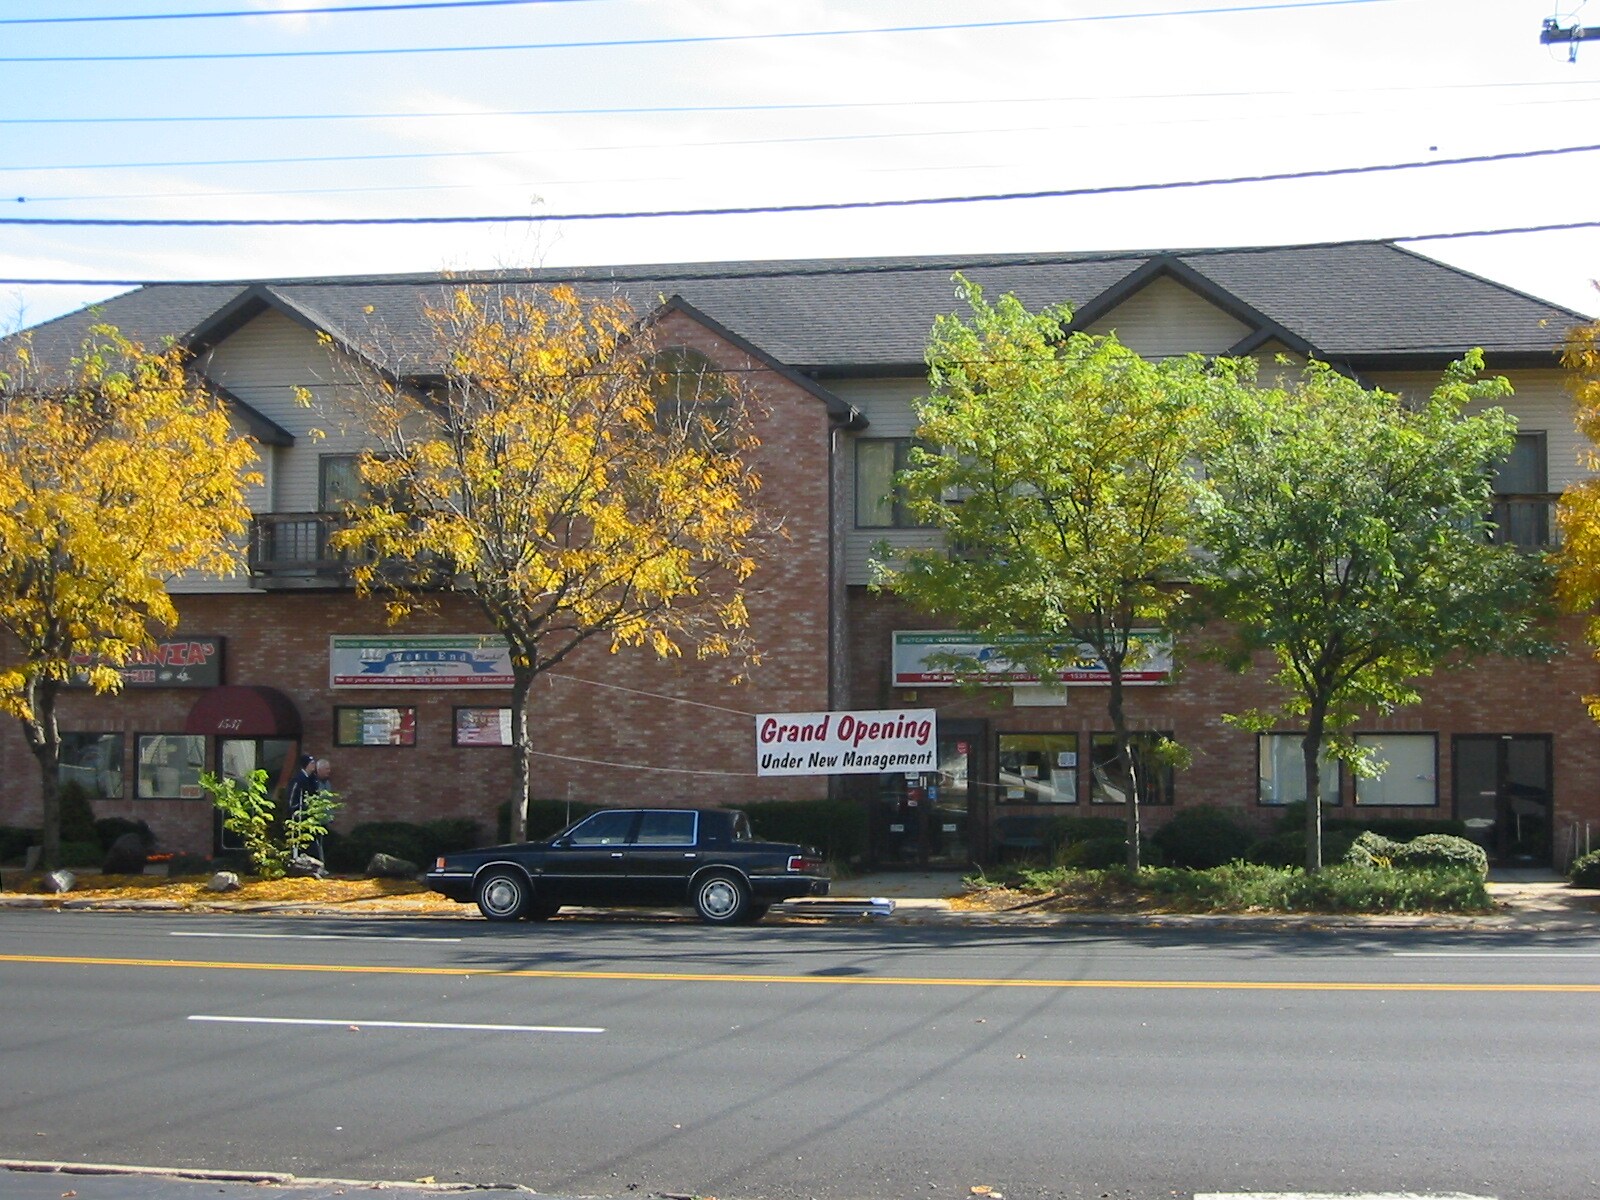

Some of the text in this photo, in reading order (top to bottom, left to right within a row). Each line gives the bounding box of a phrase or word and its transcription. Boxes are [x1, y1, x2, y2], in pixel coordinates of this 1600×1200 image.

[391, 652, 428, 662] West
[438, 651, 466, 662] End
[760, 713, 931, 748] Grand Opening
[761, 750, 932, 770] Under New Management
